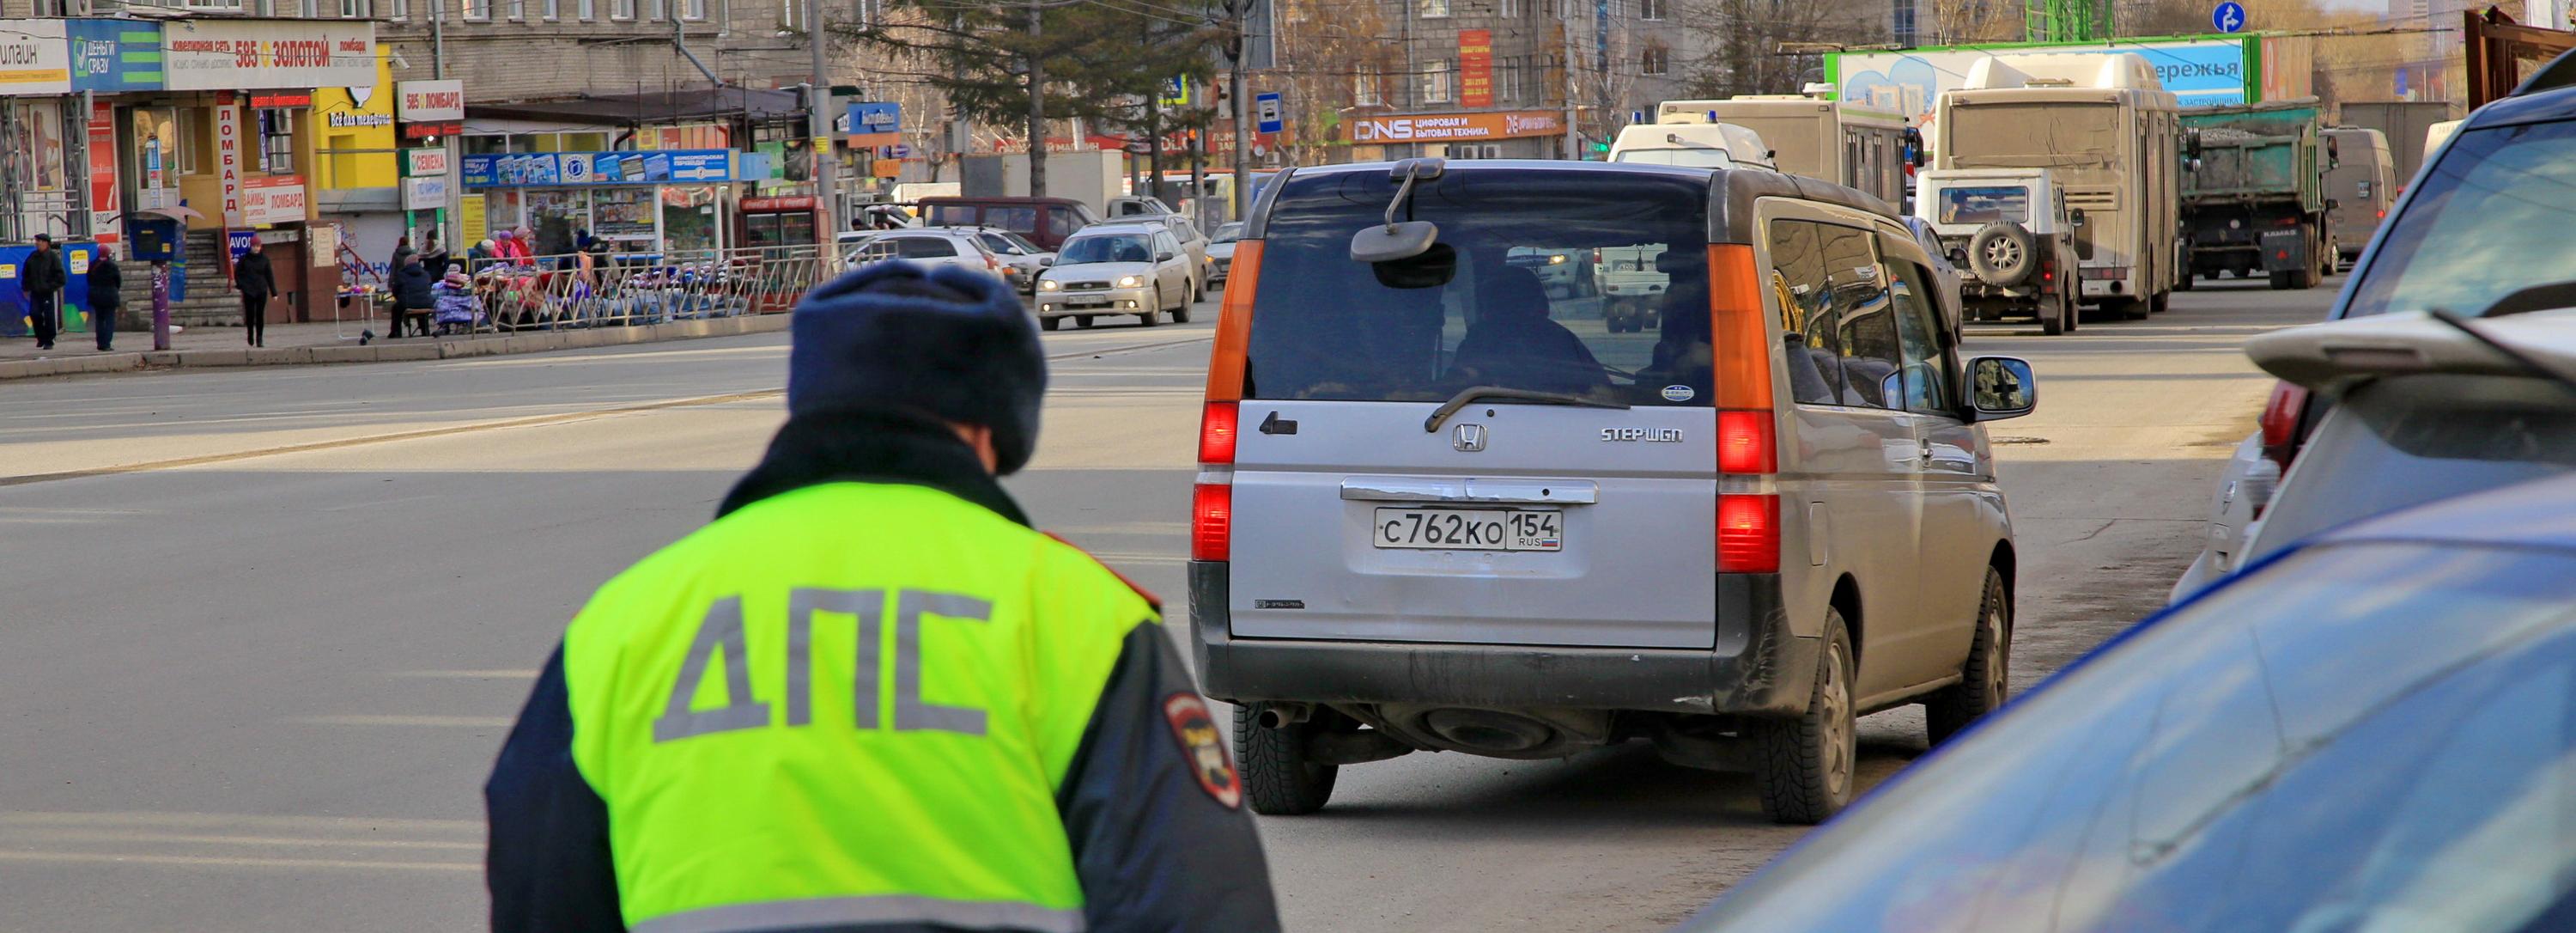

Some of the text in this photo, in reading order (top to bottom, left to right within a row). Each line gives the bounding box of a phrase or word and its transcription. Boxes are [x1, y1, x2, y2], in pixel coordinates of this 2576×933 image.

[87, 40, 115, 56] ДЕНЬГИ
[215, 41, 230, 52] сеть
[235, 34, 331, 68] 585 ЗОЛОТОЙ
[339, 39, 367, 54] ломбард
[88, 58, 109, 74] СРАЗУ
[406, 91, 461, 110] 585 ЛОМБАРД
[1354, 119, 1413, 140] DNS
[1415, 119, 1460, 128] ЦИФРОВАЯ
[1415, 127, 1489, 138] БЫТОВАЯ ТЕХНИКА
[220, 110, 237, 211] ЛОМБАРД
[416, 155, 445, 171] СЕМЕНА
[271, 192, 303, 209] ЛОМБАРД
[229, 236, 252, 249] AVO
[1383, 513, 1554, 545] С762КО 154
[1519, 538, 1541, 546] RUS
[653, 586, 993, 744] ДПС
